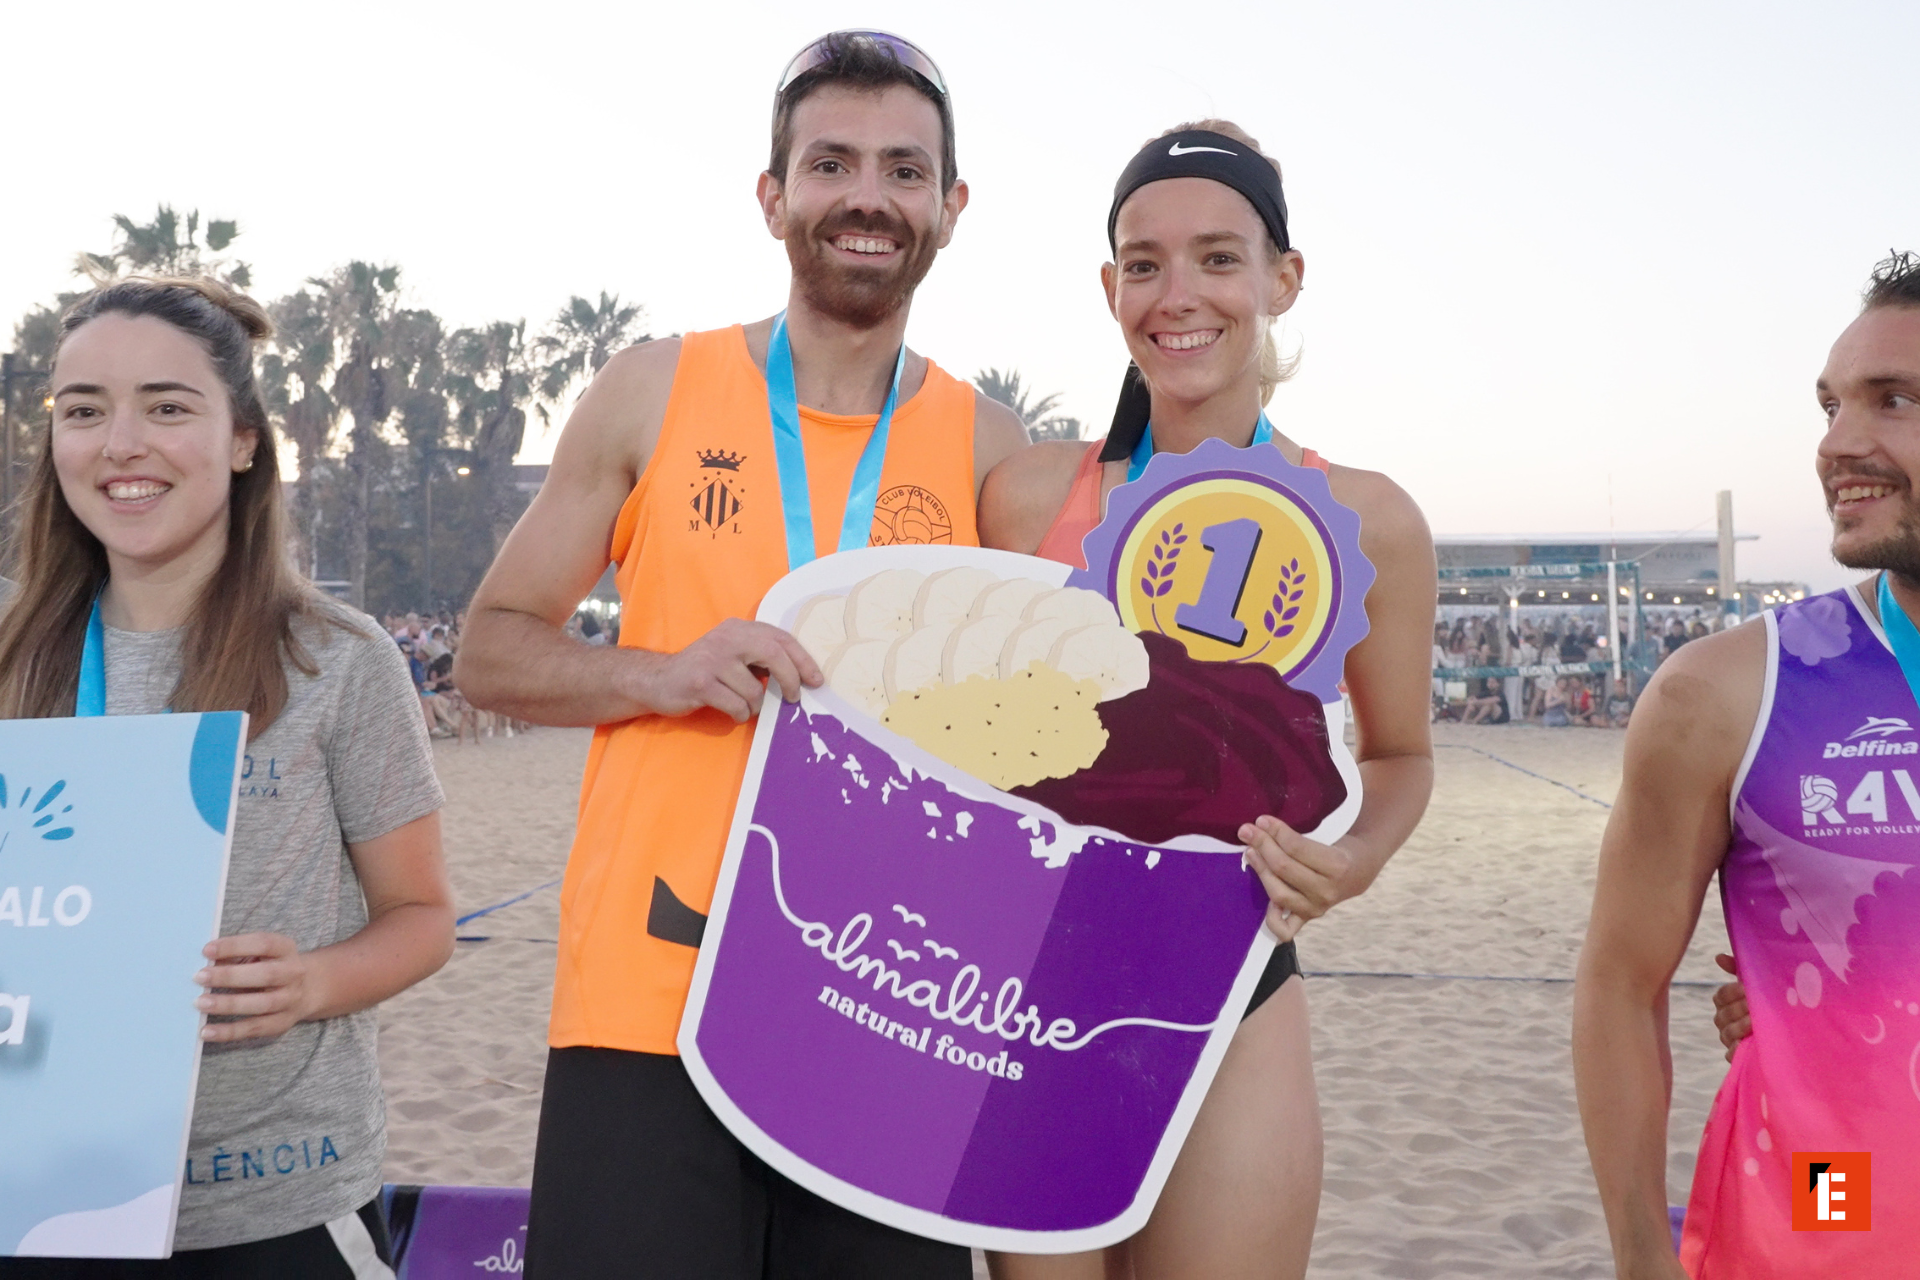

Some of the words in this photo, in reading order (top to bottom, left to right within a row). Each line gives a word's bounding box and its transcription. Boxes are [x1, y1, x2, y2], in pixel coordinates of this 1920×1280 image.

[881, 489, 905, 506] CLUB
[907, 487, 946, 522] VOLEIBOL
[688, 519, 700, 532] M
[733, 522, 742, 535] L
[1174, 517, 1263, 647] 1
[1822, 740, 1919, 759] Delfina
[1804, 828, 1841, 838] READY
[1846, 826, 1871, 835] FOR
[1874, 824, 1920, 835] VOLLEY
[0, 885, 92, 927] ALO
[802, 912, 1085, 1051] almalibre
[818, 976, 932, 1053] natural
[933, 1034, 1024, 1081] foods
